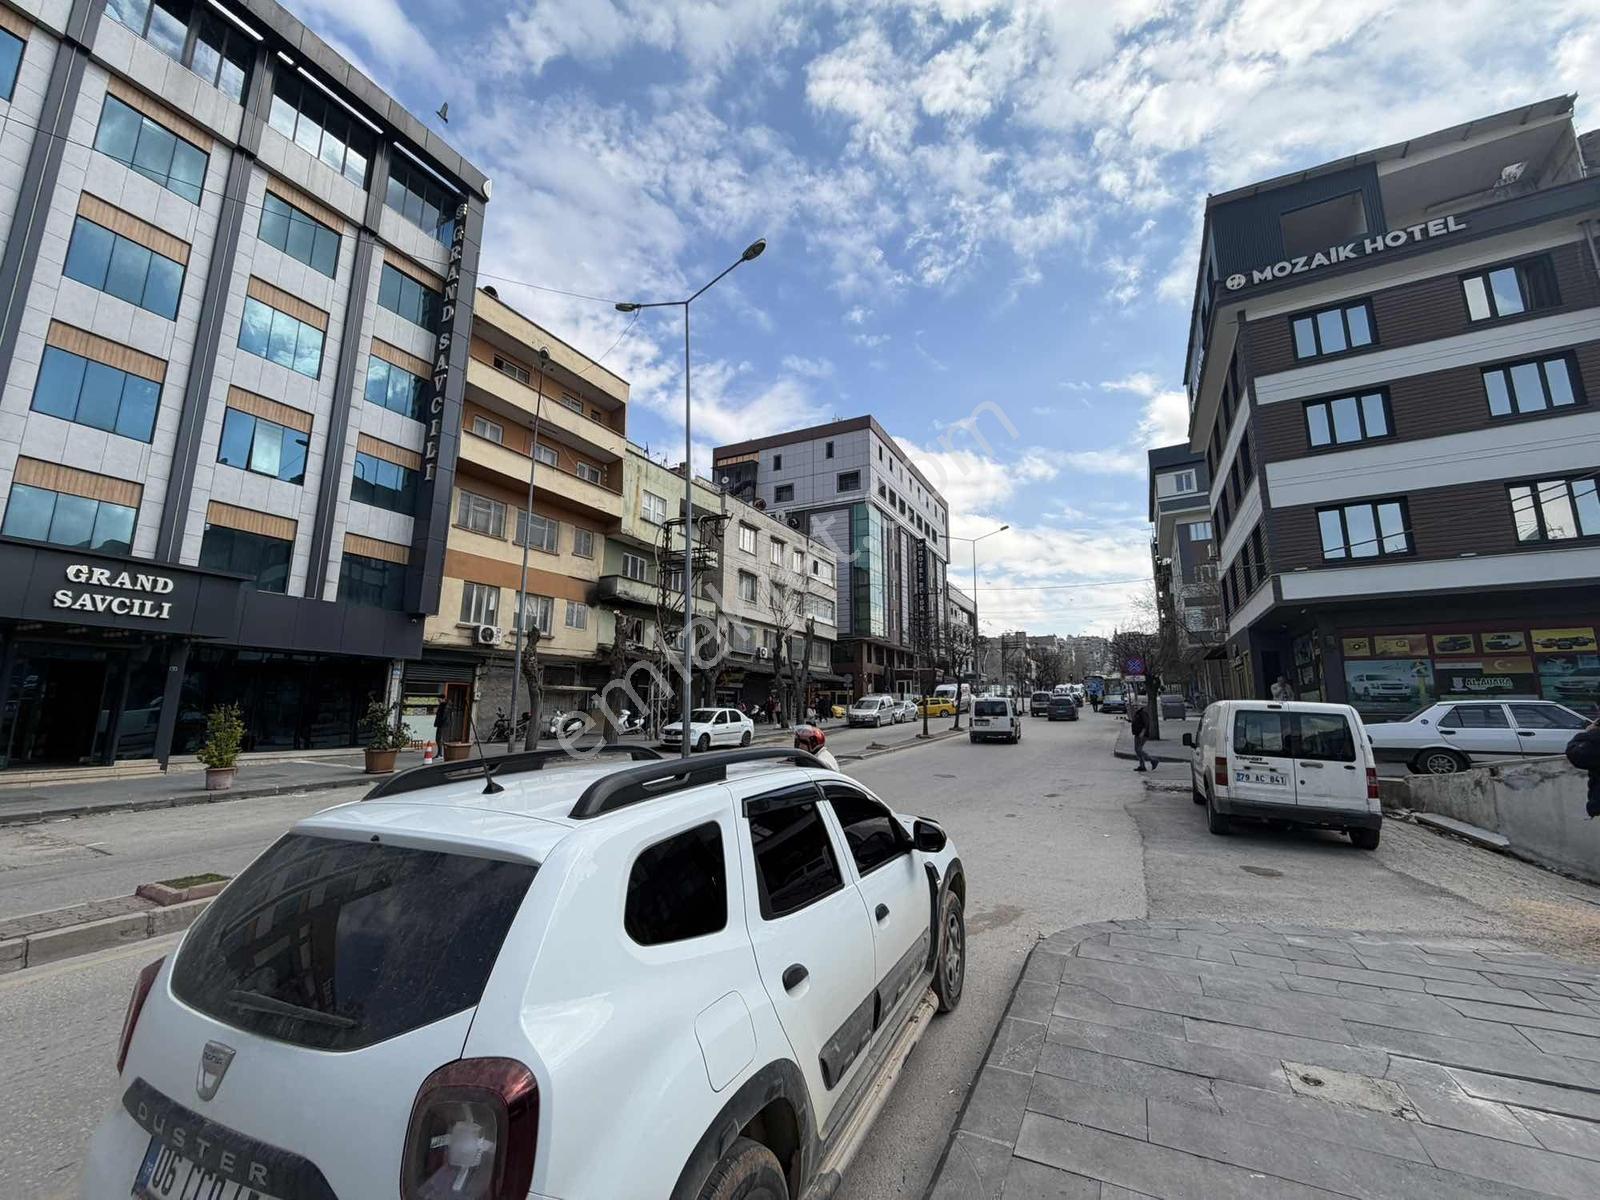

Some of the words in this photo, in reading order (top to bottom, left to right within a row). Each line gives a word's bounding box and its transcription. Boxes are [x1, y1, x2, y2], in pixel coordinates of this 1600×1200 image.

[1364, 215, 1467, 254] HOTEL
[441, 226, 465, 323] GRAND
[424, 332, 450, 481] SAVCILI
[53, 589, 172, 619] SAVCILI
[66, 564, 174, 594] GRAND
[137, 1101, 268, 1186] DUSTER
